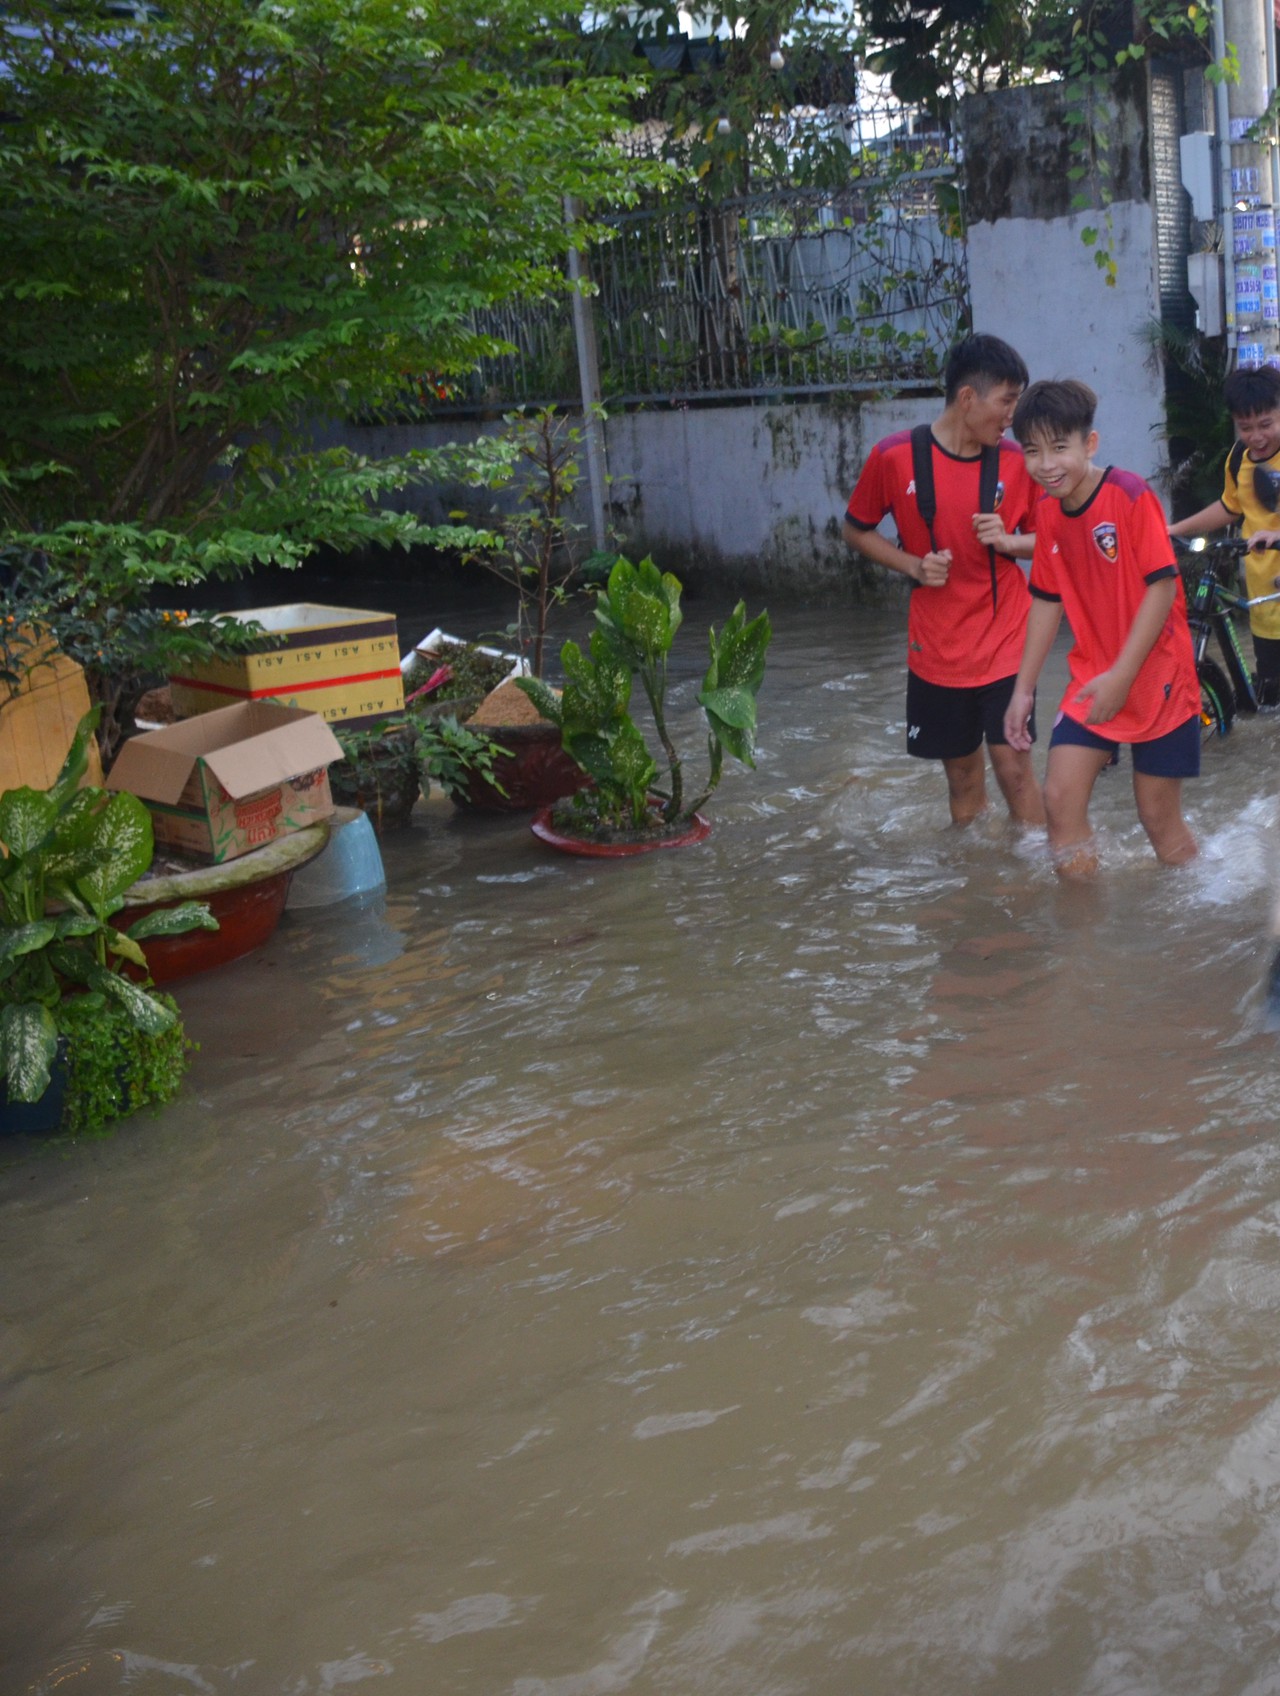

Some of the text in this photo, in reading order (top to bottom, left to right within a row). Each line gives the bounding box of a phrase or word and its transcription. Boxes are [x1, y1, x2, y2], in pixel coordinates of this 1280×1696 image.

[258, 640, 394, 668] A.S.I A.S.I A.S.I A.S.I
[323, 707, 348, 718] A.S.I
[360, 701, 384, 712] A.S.I
